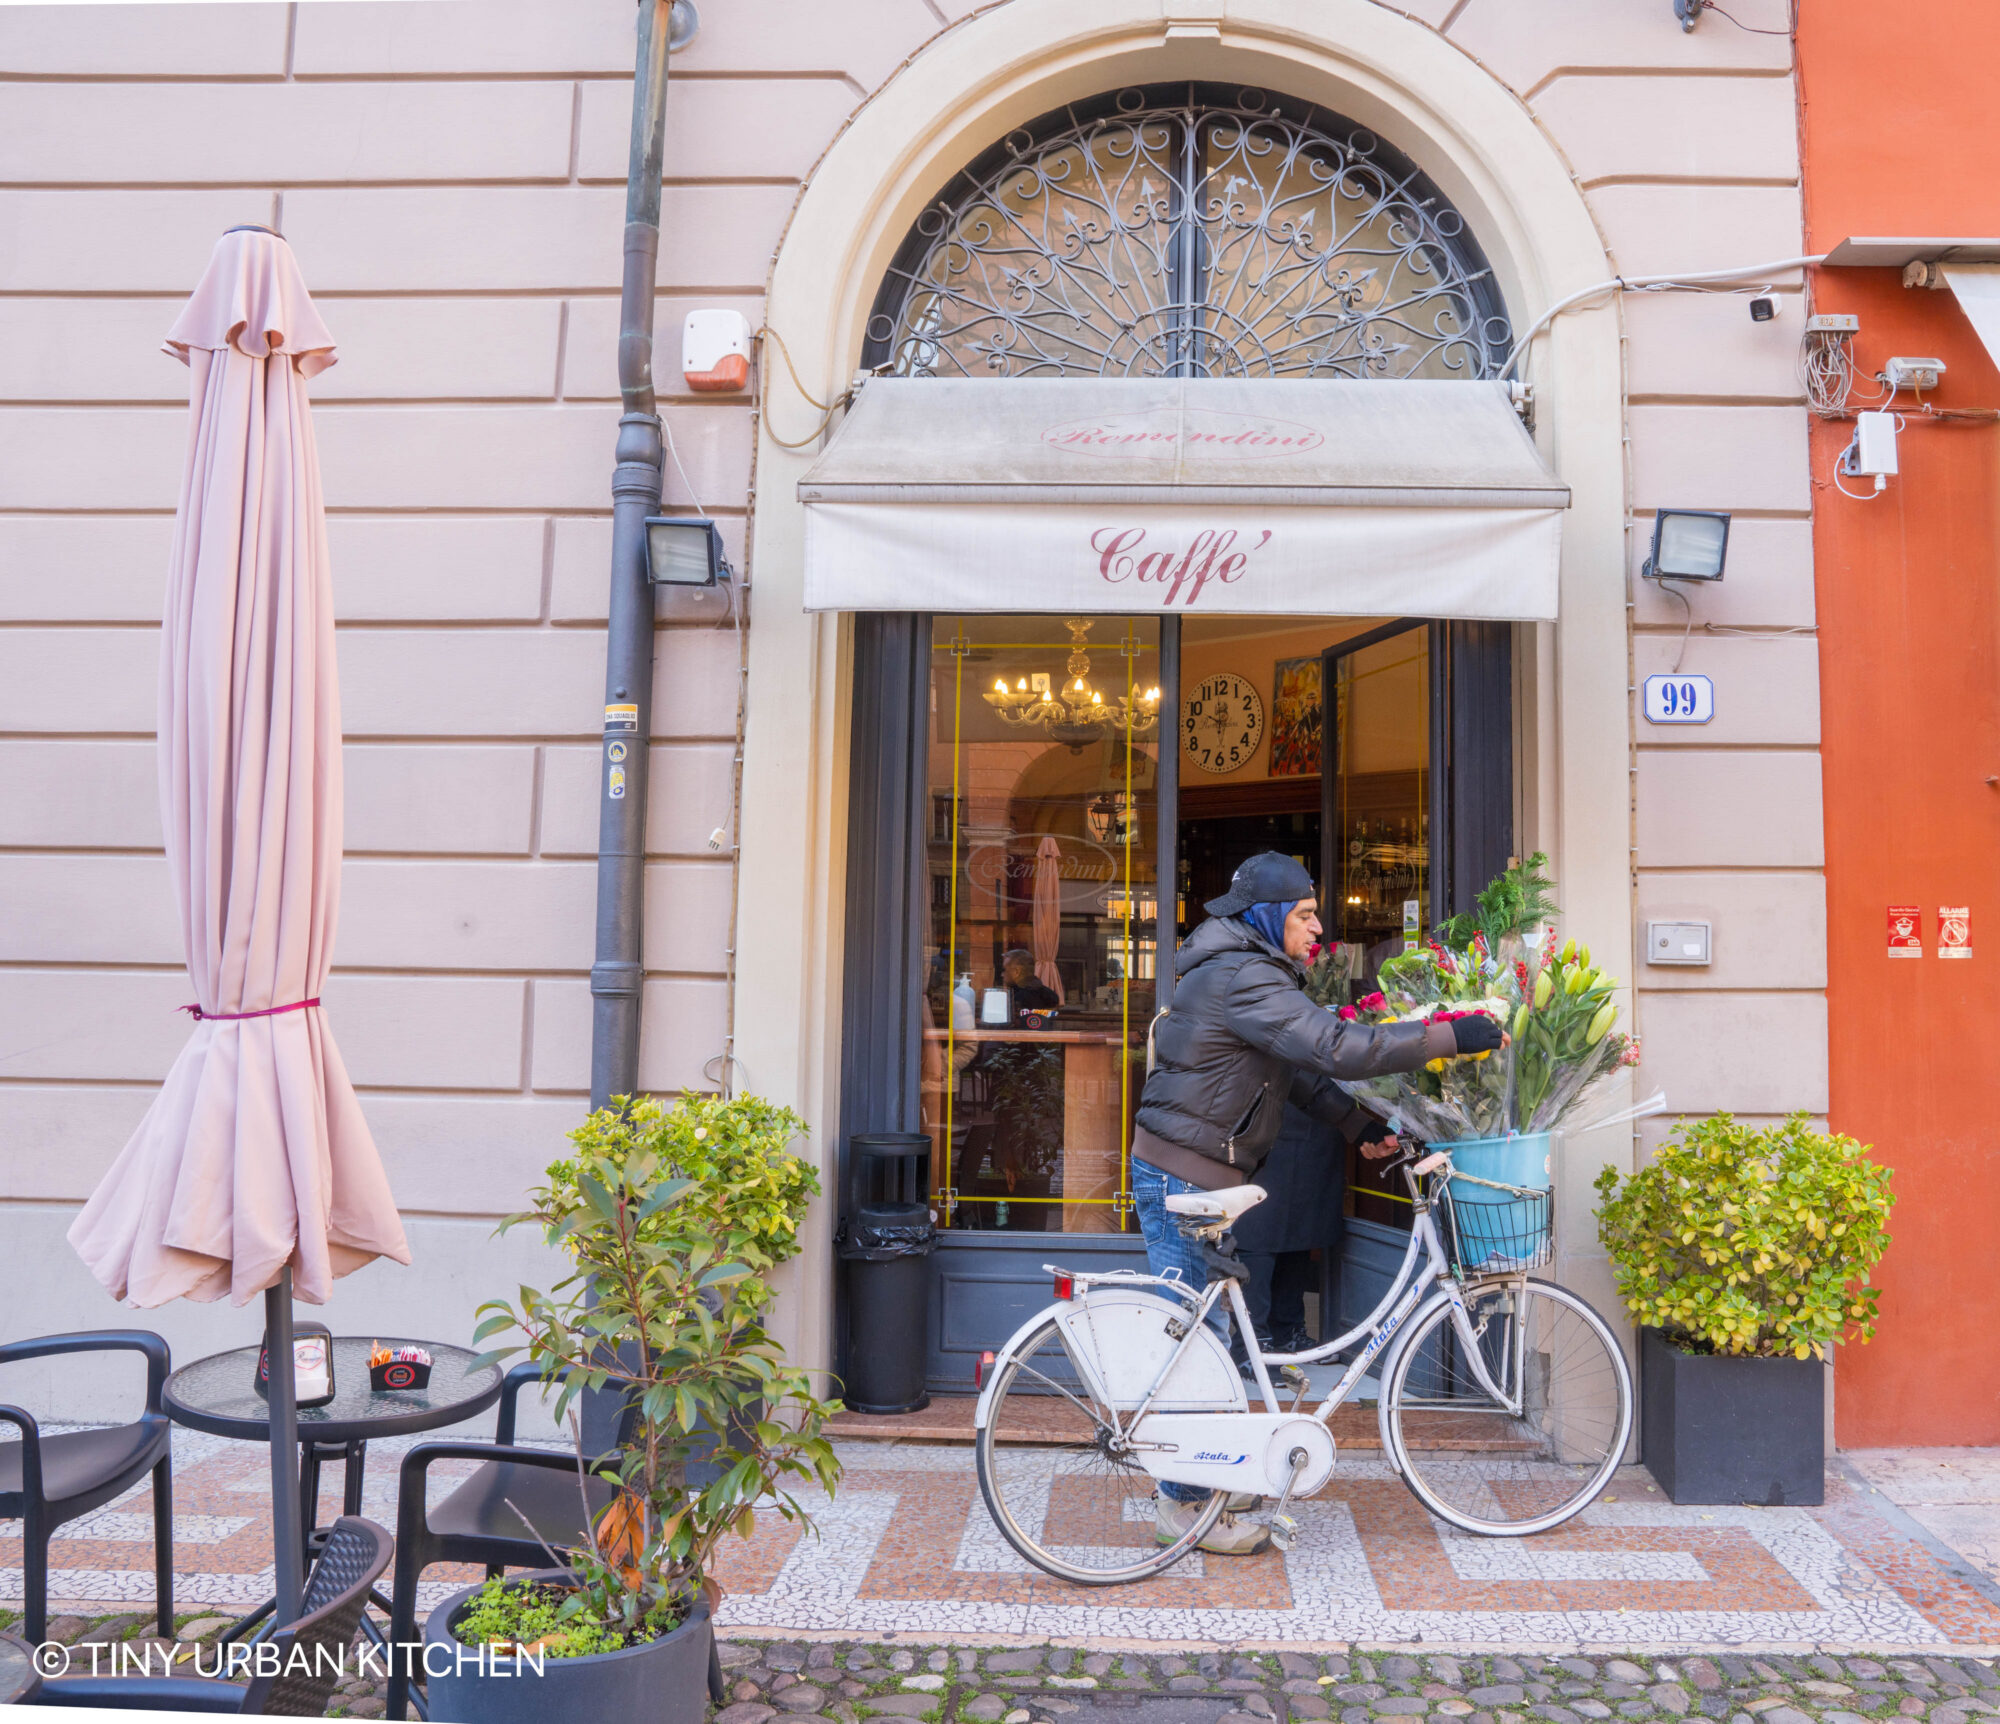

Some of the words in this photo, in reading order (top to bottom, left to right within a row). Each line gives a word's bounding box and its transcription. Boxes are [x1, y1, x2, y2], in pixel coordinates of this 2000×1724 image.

[1202, 685, 1211, 701] 11
[1215, 680, 1228, 696] 12
[1235, 683, 1239, 698] 1
[1242, 695, 1252, 711] 2
[1661, 682, 1697, 716] 99
[1190, 701, 1203, 716] 10
[1186, 718, 1196, 733] 9
[1246, 713, 1256, 729] 3
[1189, 736, 1199, 751] 8
[1240, 732, 1249, 747] 4
[1202, 749, 1211, 764] 7
[1215, 751, 1225, 767] 6
[1230, 746, 1240, 762] 5
[981, 854, 1106, 878] Remndini
